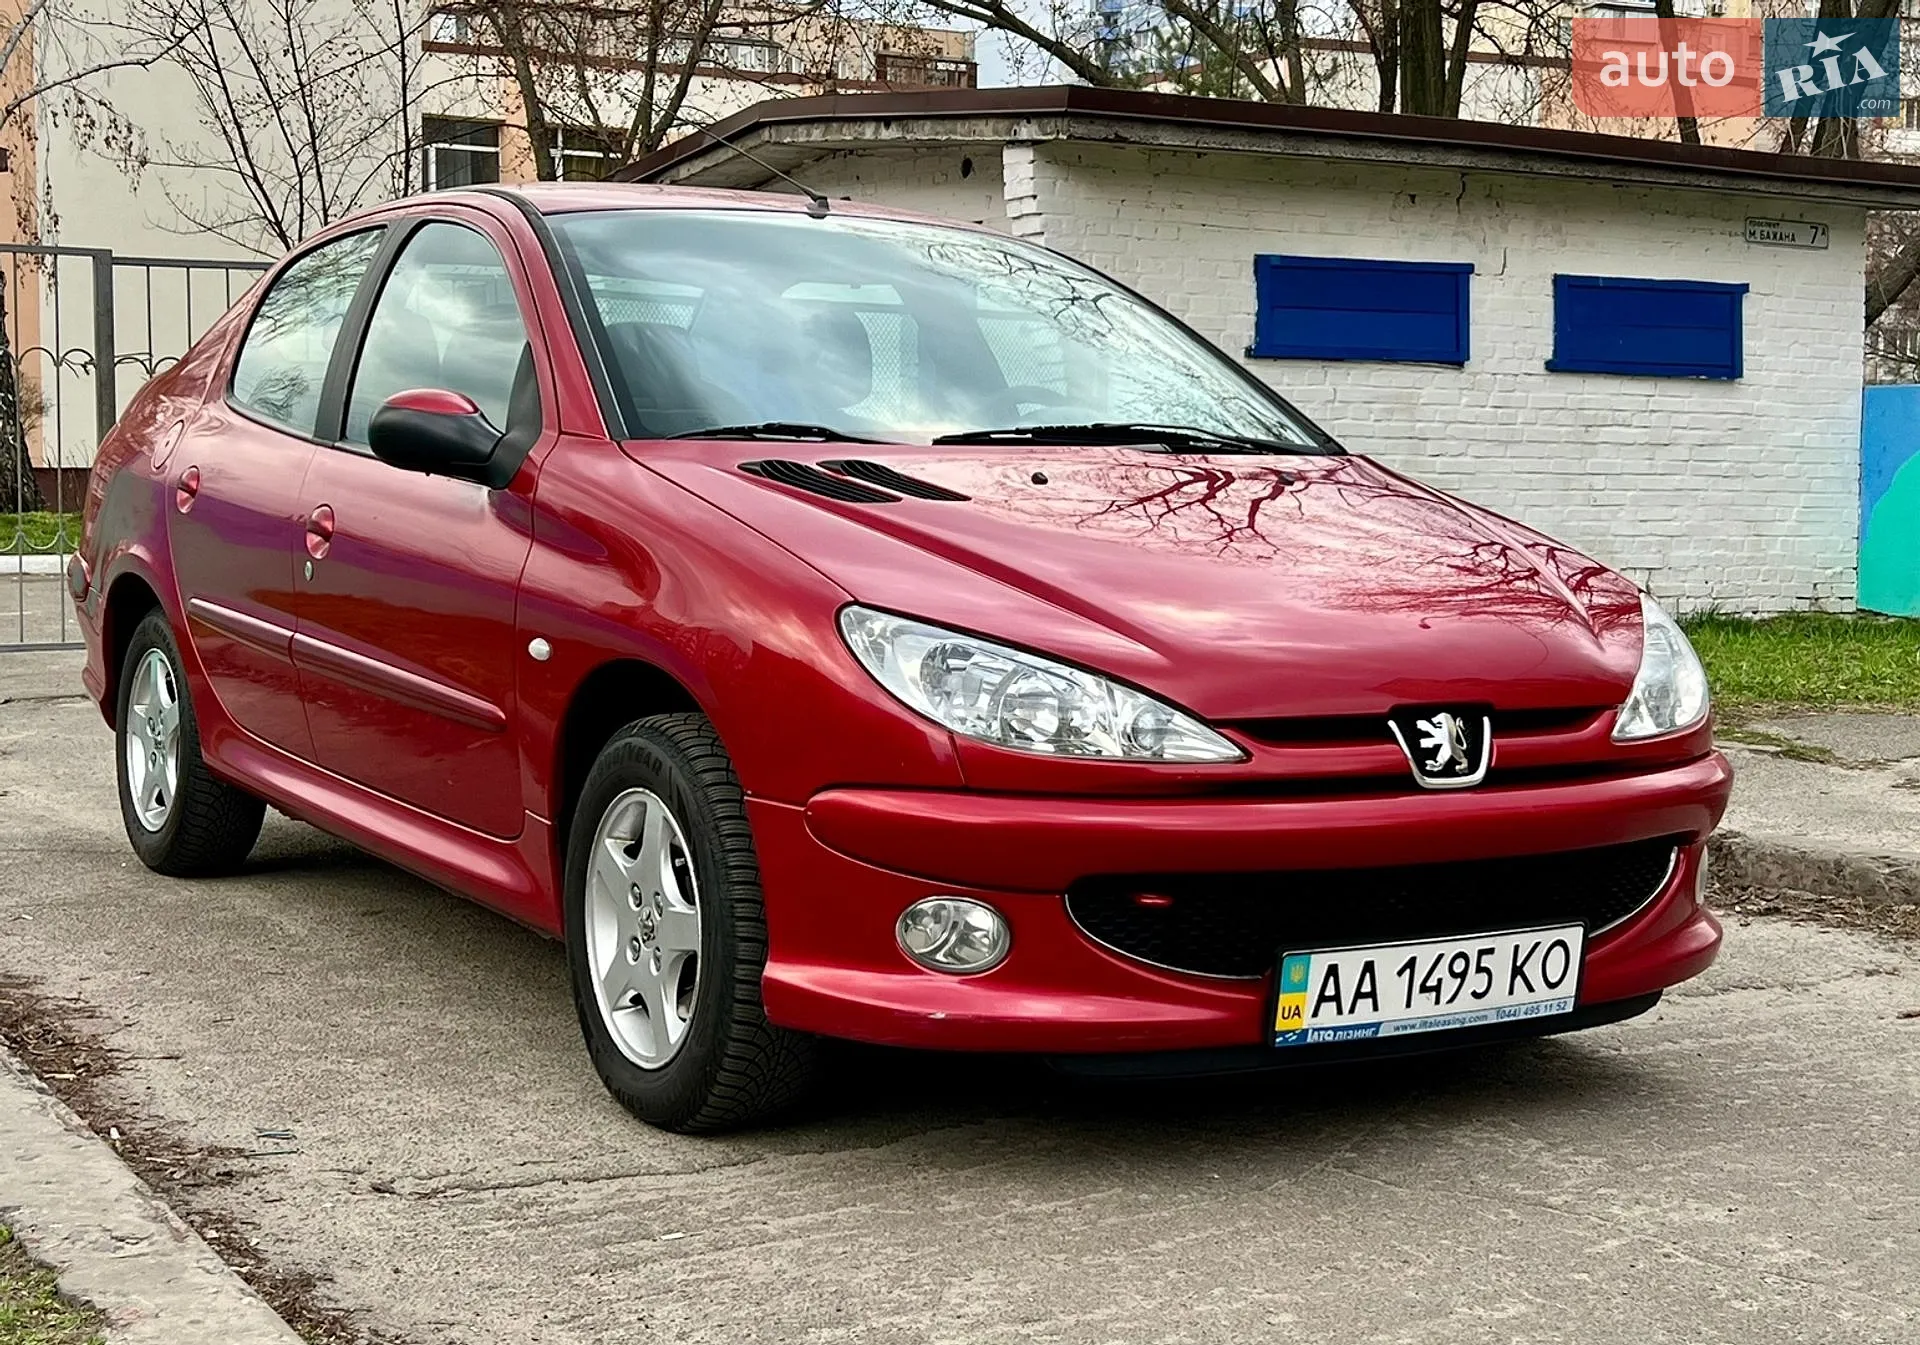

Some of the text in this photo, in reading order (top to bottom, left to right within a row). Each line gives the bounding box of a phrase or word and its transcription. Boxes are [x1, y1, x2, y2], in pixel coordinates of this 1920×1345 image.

[1760, 230, 1796, 243] БАЖАНА
[1312, 938, 1570, 1018] AA 1495 KO
[1281, 1005, 1301, 1020] UA
[1523, 1005, 1541, 1016] 495
[1544, 1003, 1553, 1013] 11
[1556, 1001, 1568, 1011] 52
